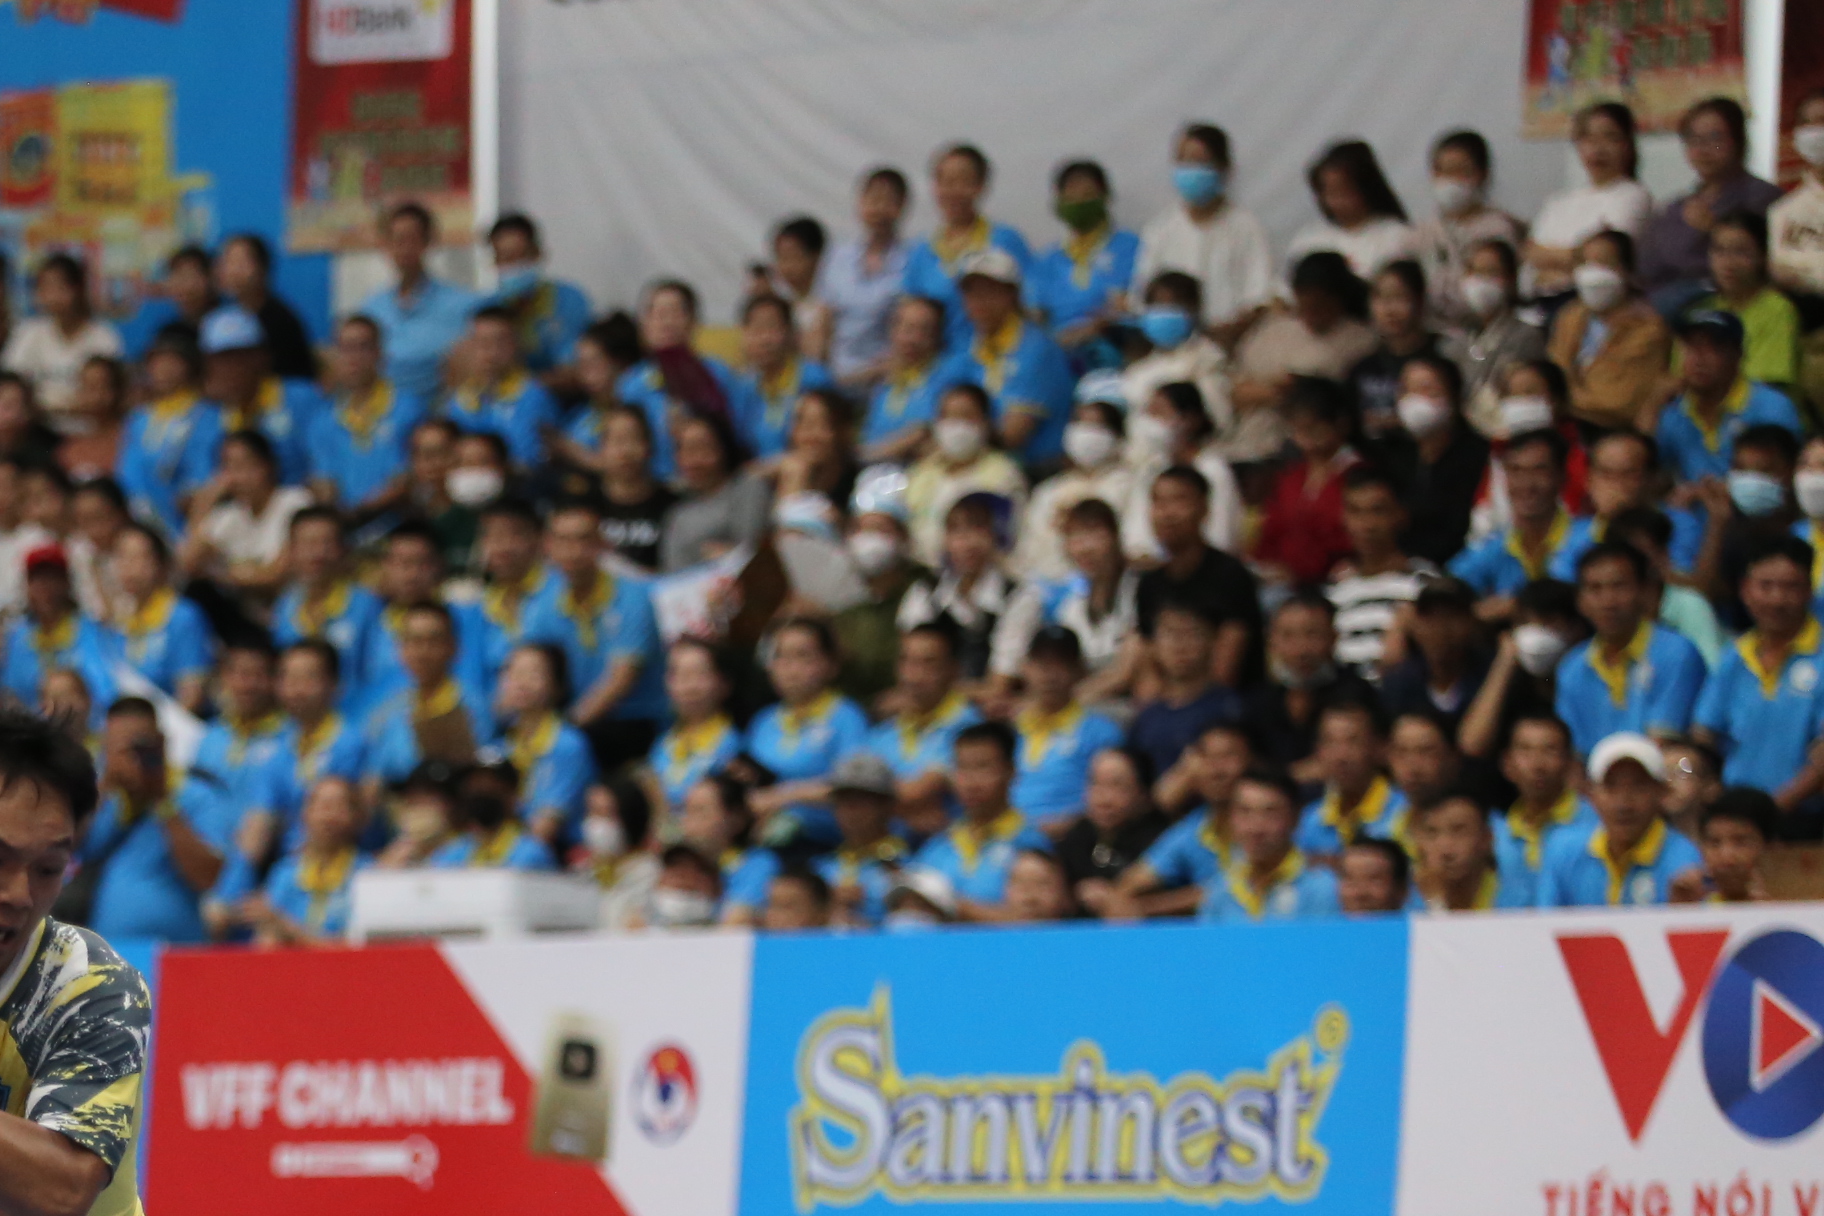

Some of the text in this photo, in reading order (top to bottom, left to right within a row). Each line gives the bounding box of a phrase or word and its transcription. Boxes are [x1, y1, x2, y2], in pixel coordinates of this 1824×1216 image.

[180, 1057, 514, 1130] VFF CHANNEL
[793, 990, 1341, 1208] Sanvinest
